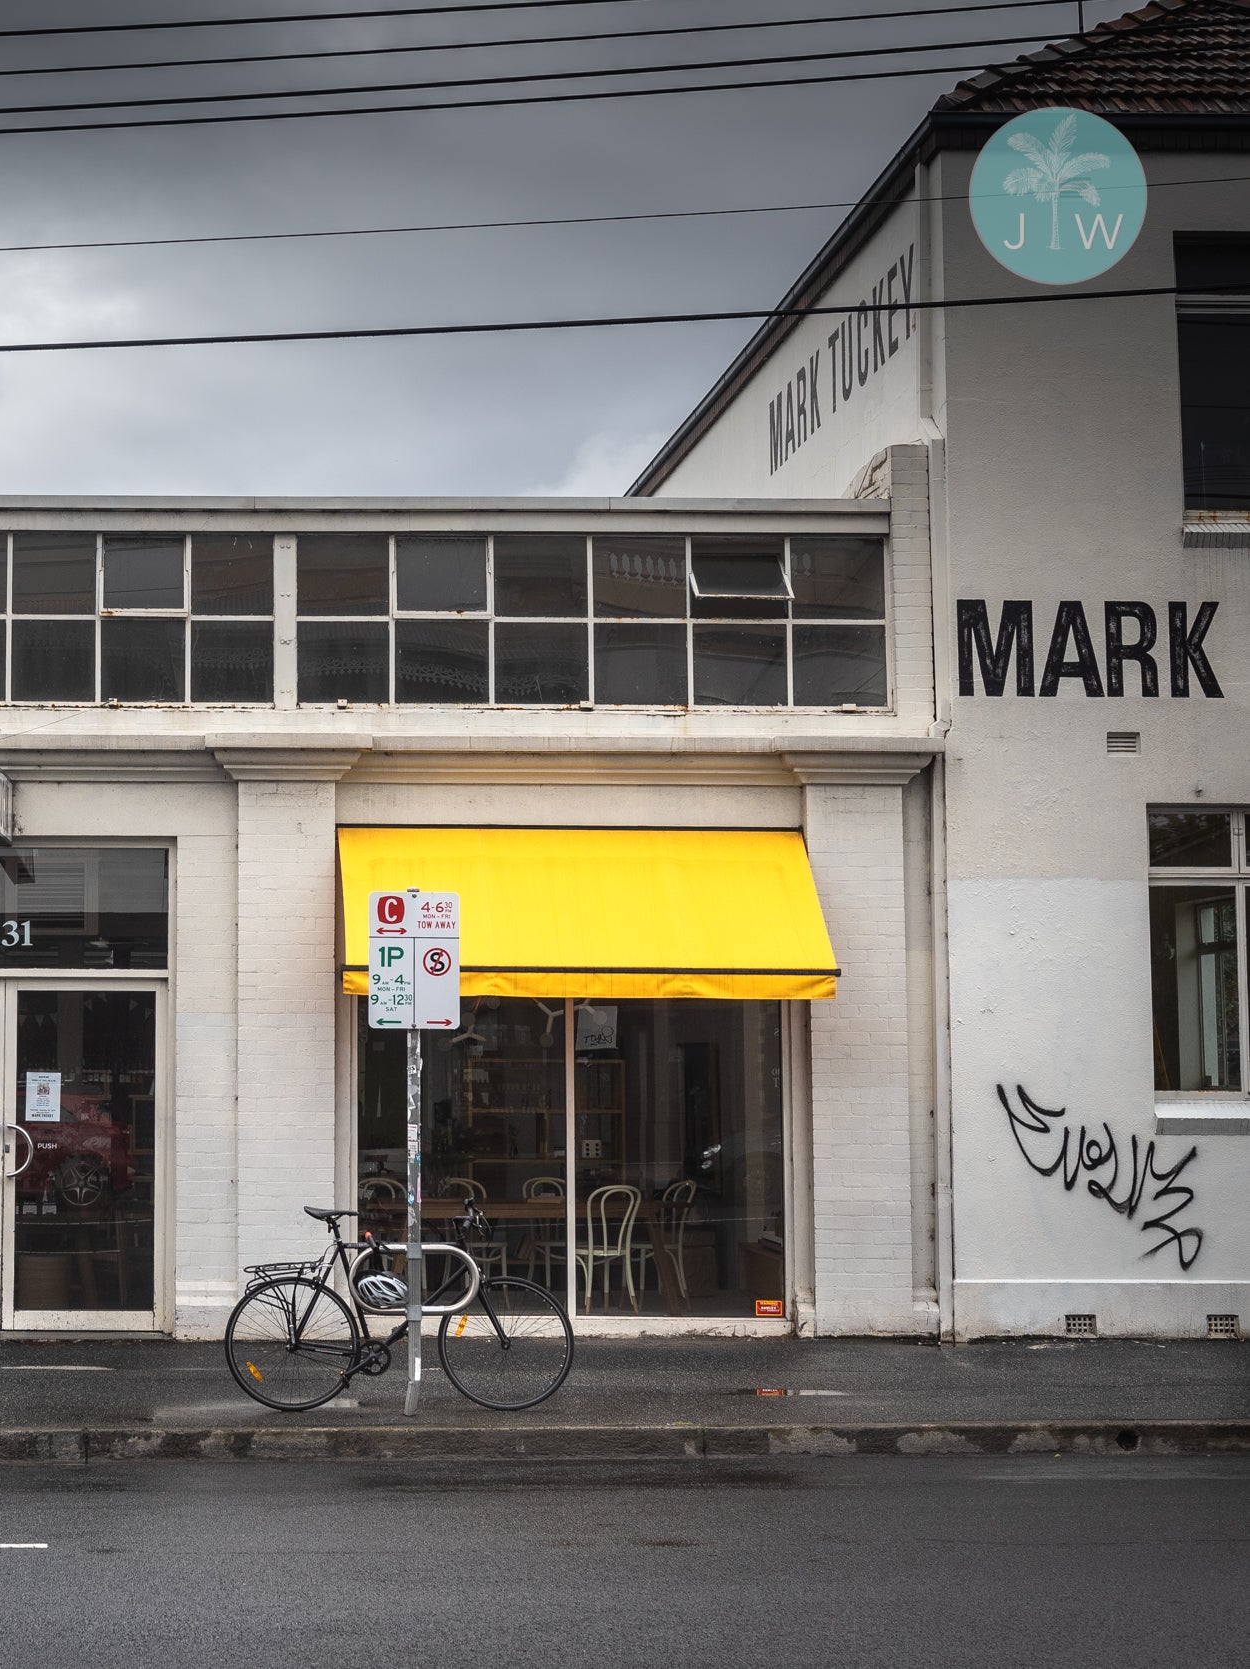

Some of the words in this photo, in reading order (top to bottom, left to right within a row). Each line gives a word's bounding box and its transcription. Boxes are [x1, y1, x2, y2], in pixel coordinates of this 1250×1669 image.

[769, 349, 822, 476] MARK
[828, 242, 915, 414] TUCKEY
[956, 599, 1224, 699] MARK
[384, 898, 398, 922] C
[417, 921, 433, 929] TOW
[434, 921, 456, 929] AWAY
[378, 946, 405, 967] 1P
[37, 1142, 58, 1150] PUSH
